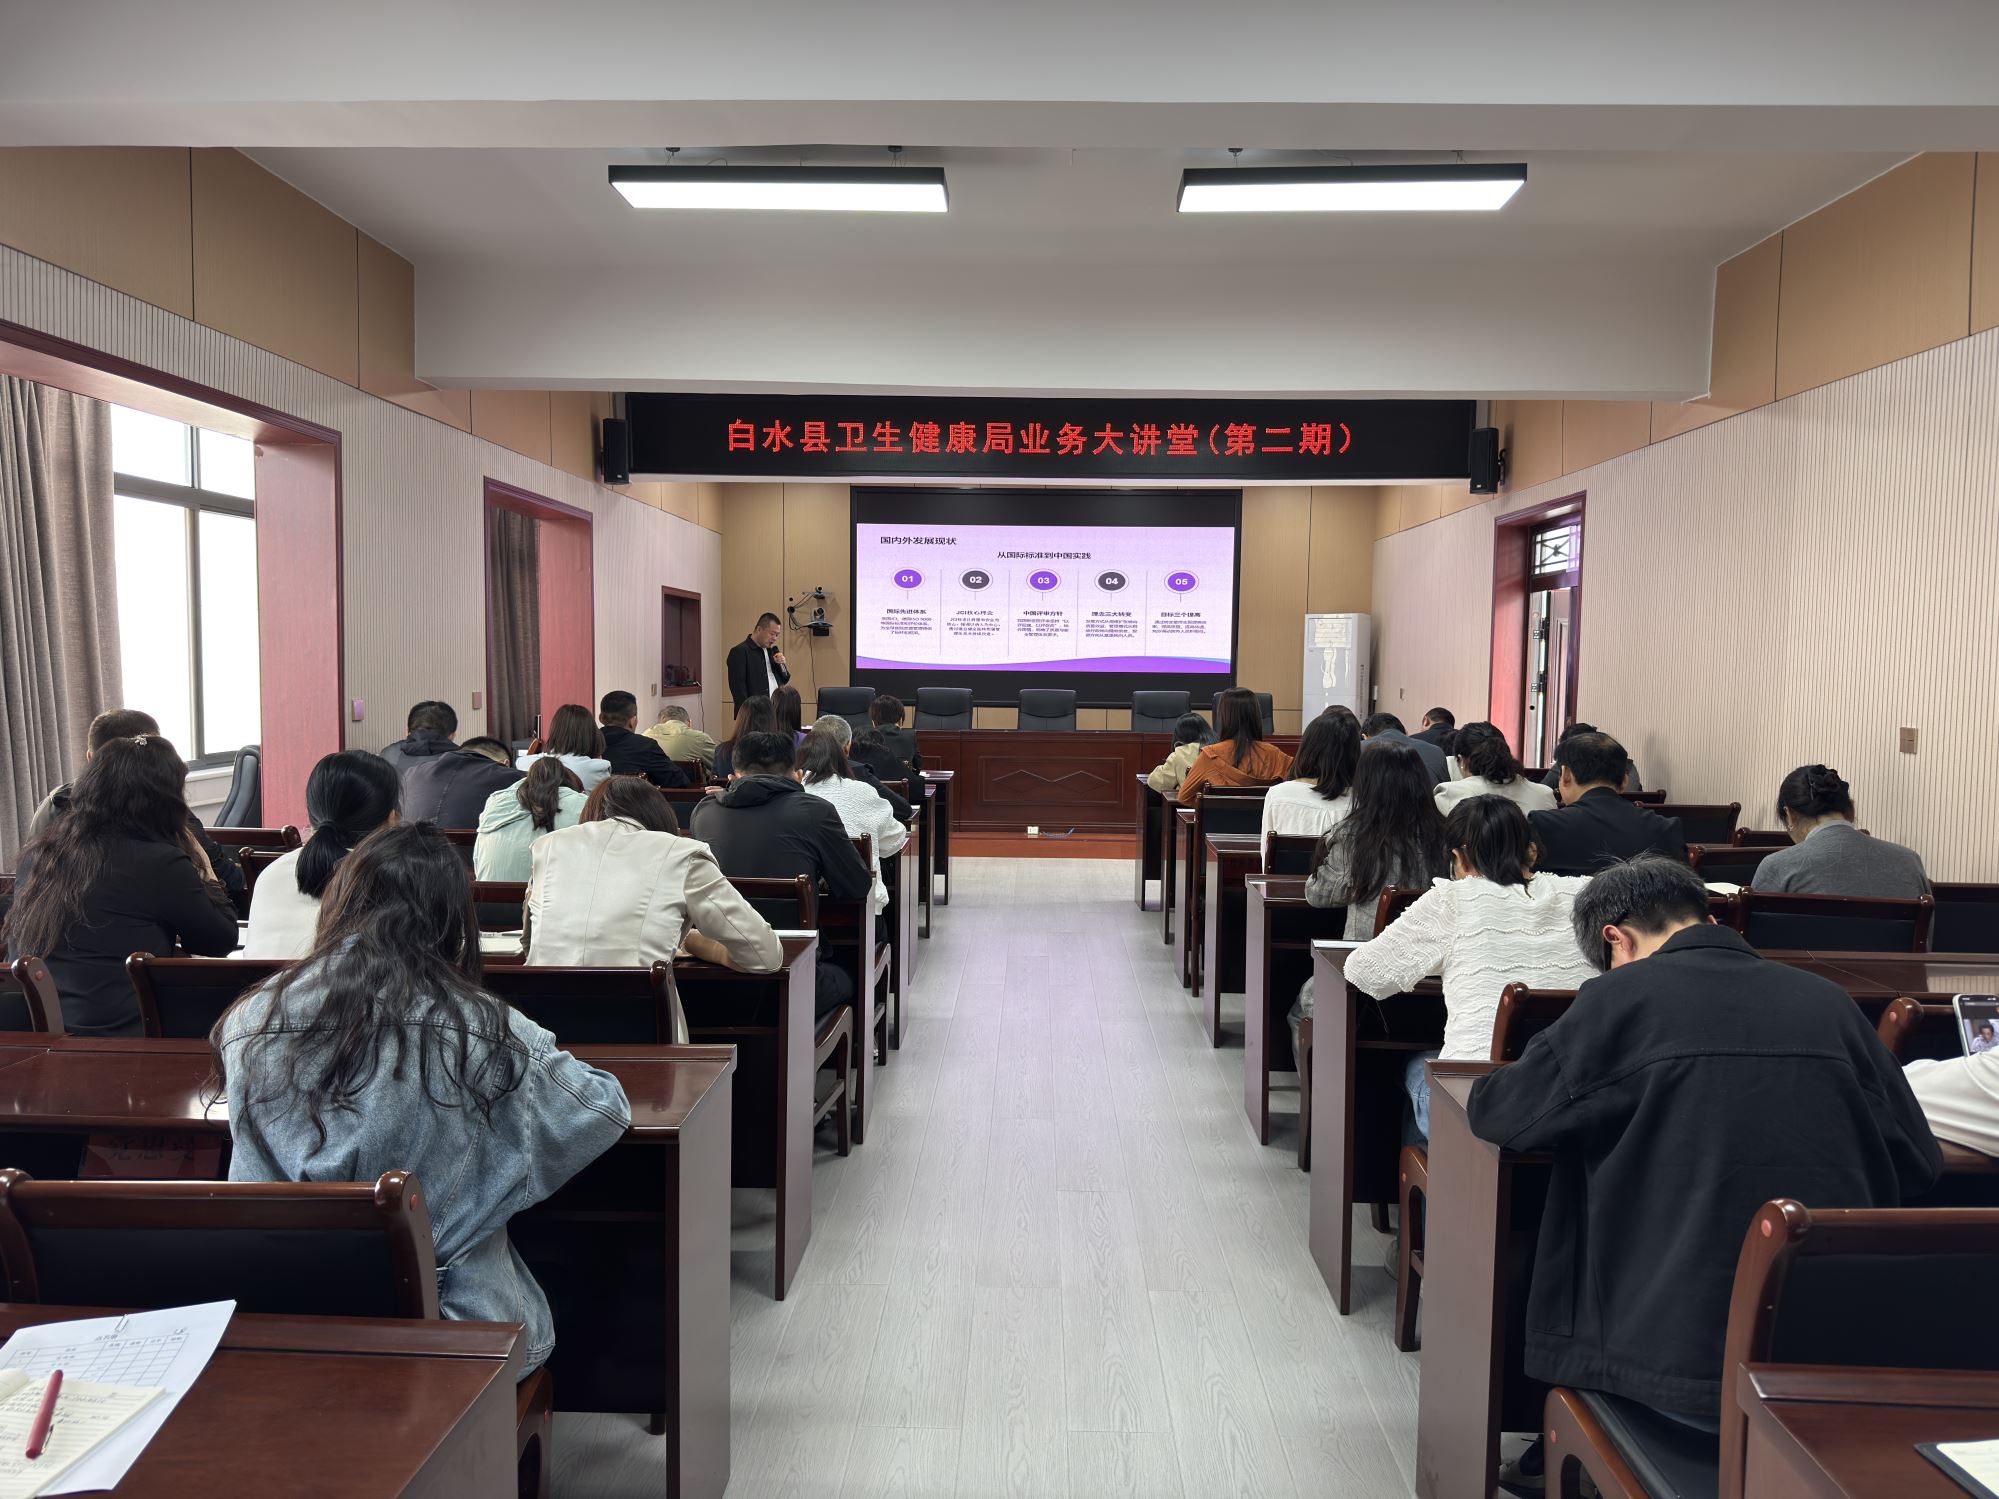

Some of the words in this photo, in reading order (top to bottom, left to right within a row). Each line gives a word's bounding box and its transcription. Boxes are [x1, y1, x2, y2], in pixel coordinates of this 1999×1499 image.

[880, 536, 957, 546] 国内外发展现状
[997, 551, 1091, 560] 从国际标准到中国实践
[901, 575, 914, 583] 01
[969, 576, 982, 584] 02
[1037, 576, 1050, 584] 03
[1105, 577, 1119, 585] 04
[1175, 578, 1188, 586] 05
